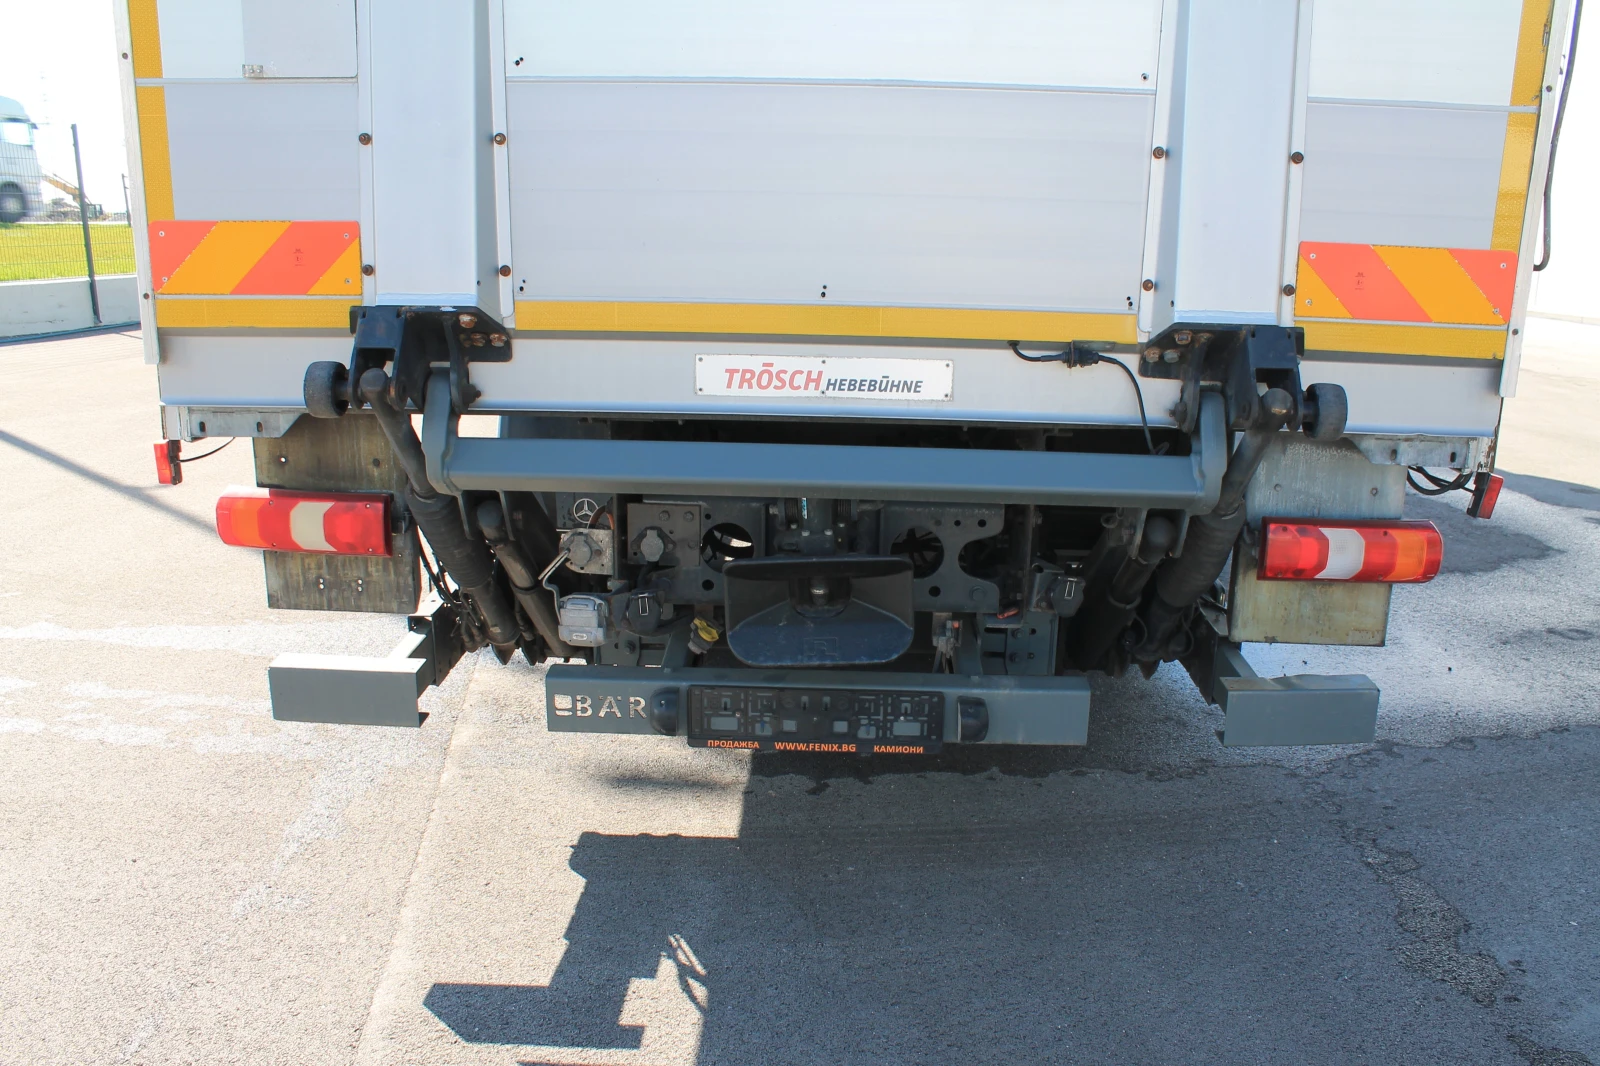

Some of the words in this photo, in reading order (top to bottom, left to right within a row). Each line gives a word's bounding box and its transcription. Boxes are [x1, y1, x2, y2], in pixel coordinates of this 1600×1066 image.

[575, 694, 647, 718] BÄR
[707, 739, 760, 749] ПРОДАЖБА
[774, 741, 857, 752] WWW.FENIX.BG
[873, 744, 924, 754] КАМИОНИ
